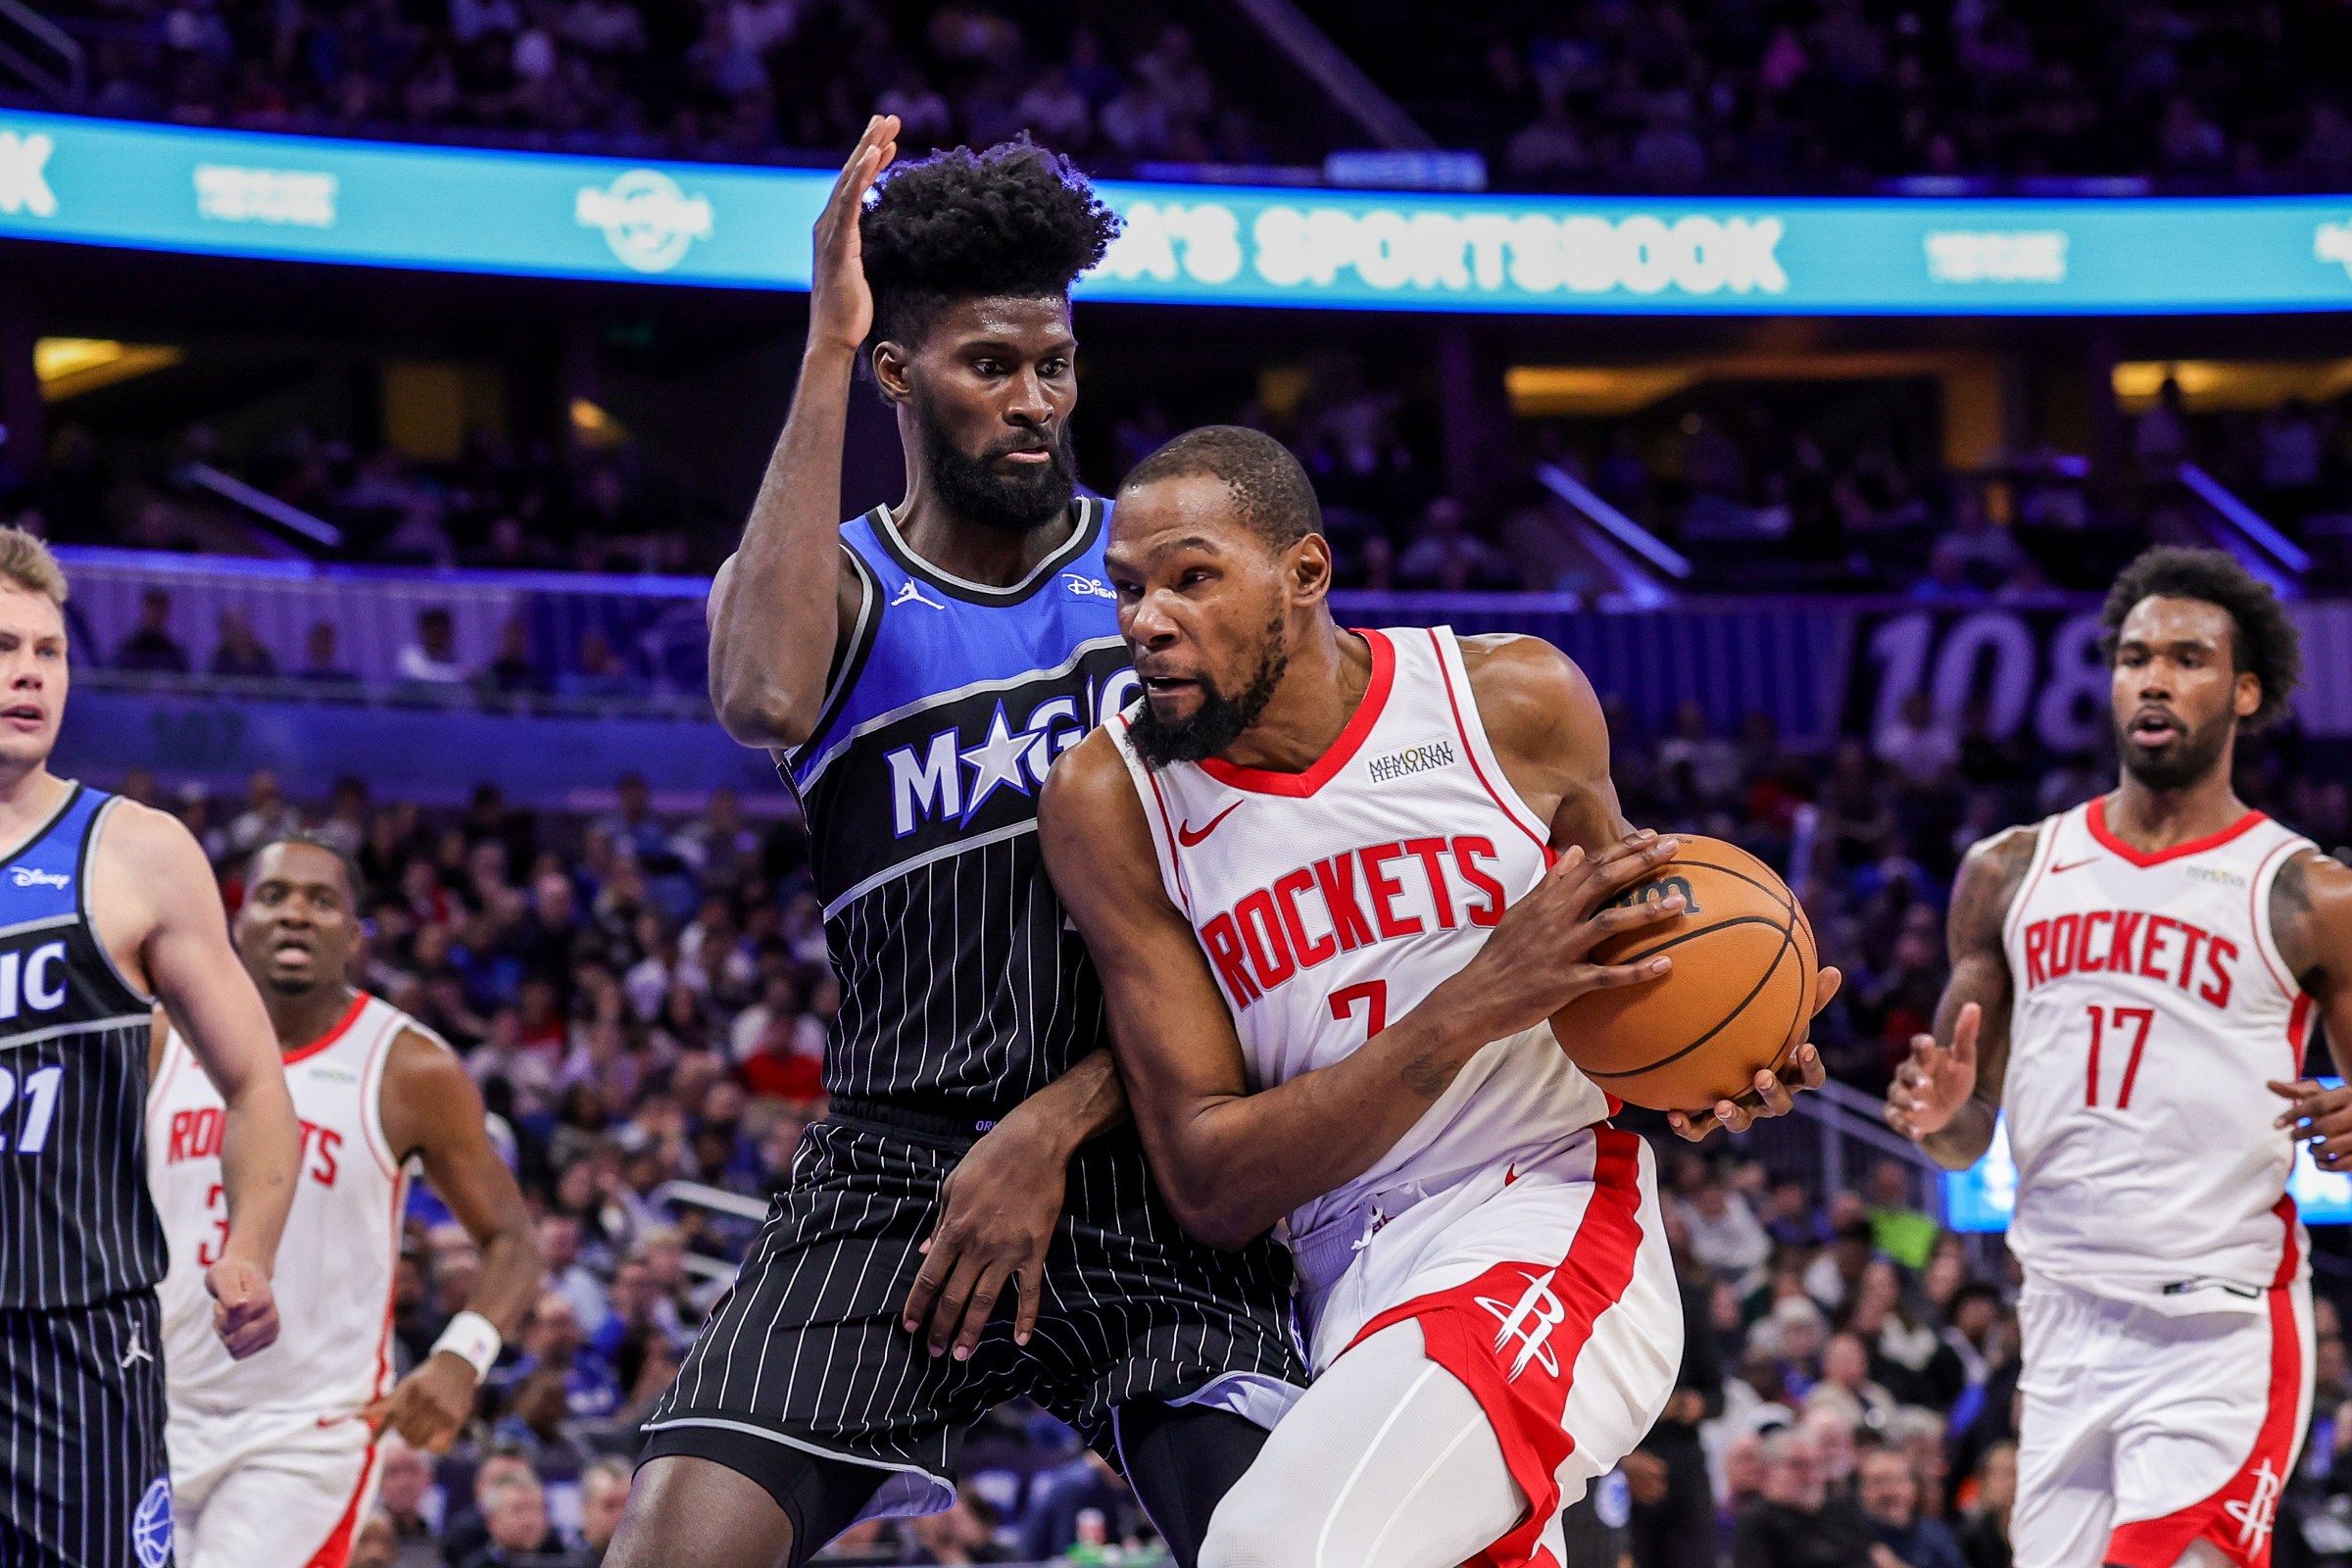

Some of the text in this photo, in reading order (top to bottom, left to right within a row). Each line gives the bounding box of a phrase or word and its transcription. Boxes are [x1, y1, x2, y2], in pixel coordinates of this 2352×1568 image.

[1093, 203, 1789, 292] A'S SPORTSBOOK
[1368, 741, 1453, 774] MEMORIAL
[1371, 751, 1454, 783] HERMANN
[1199, 834, 1506, 1012] ROCKETS
[2024, 909, 2240, 1010] ROCKETS
[1328, 979, 1387, 1041] 7
[2085, 1005, 2154, 1111] 17
[167, 1107, 345, 1190] ROTS
[197, 1183, 231, 1268] 3
